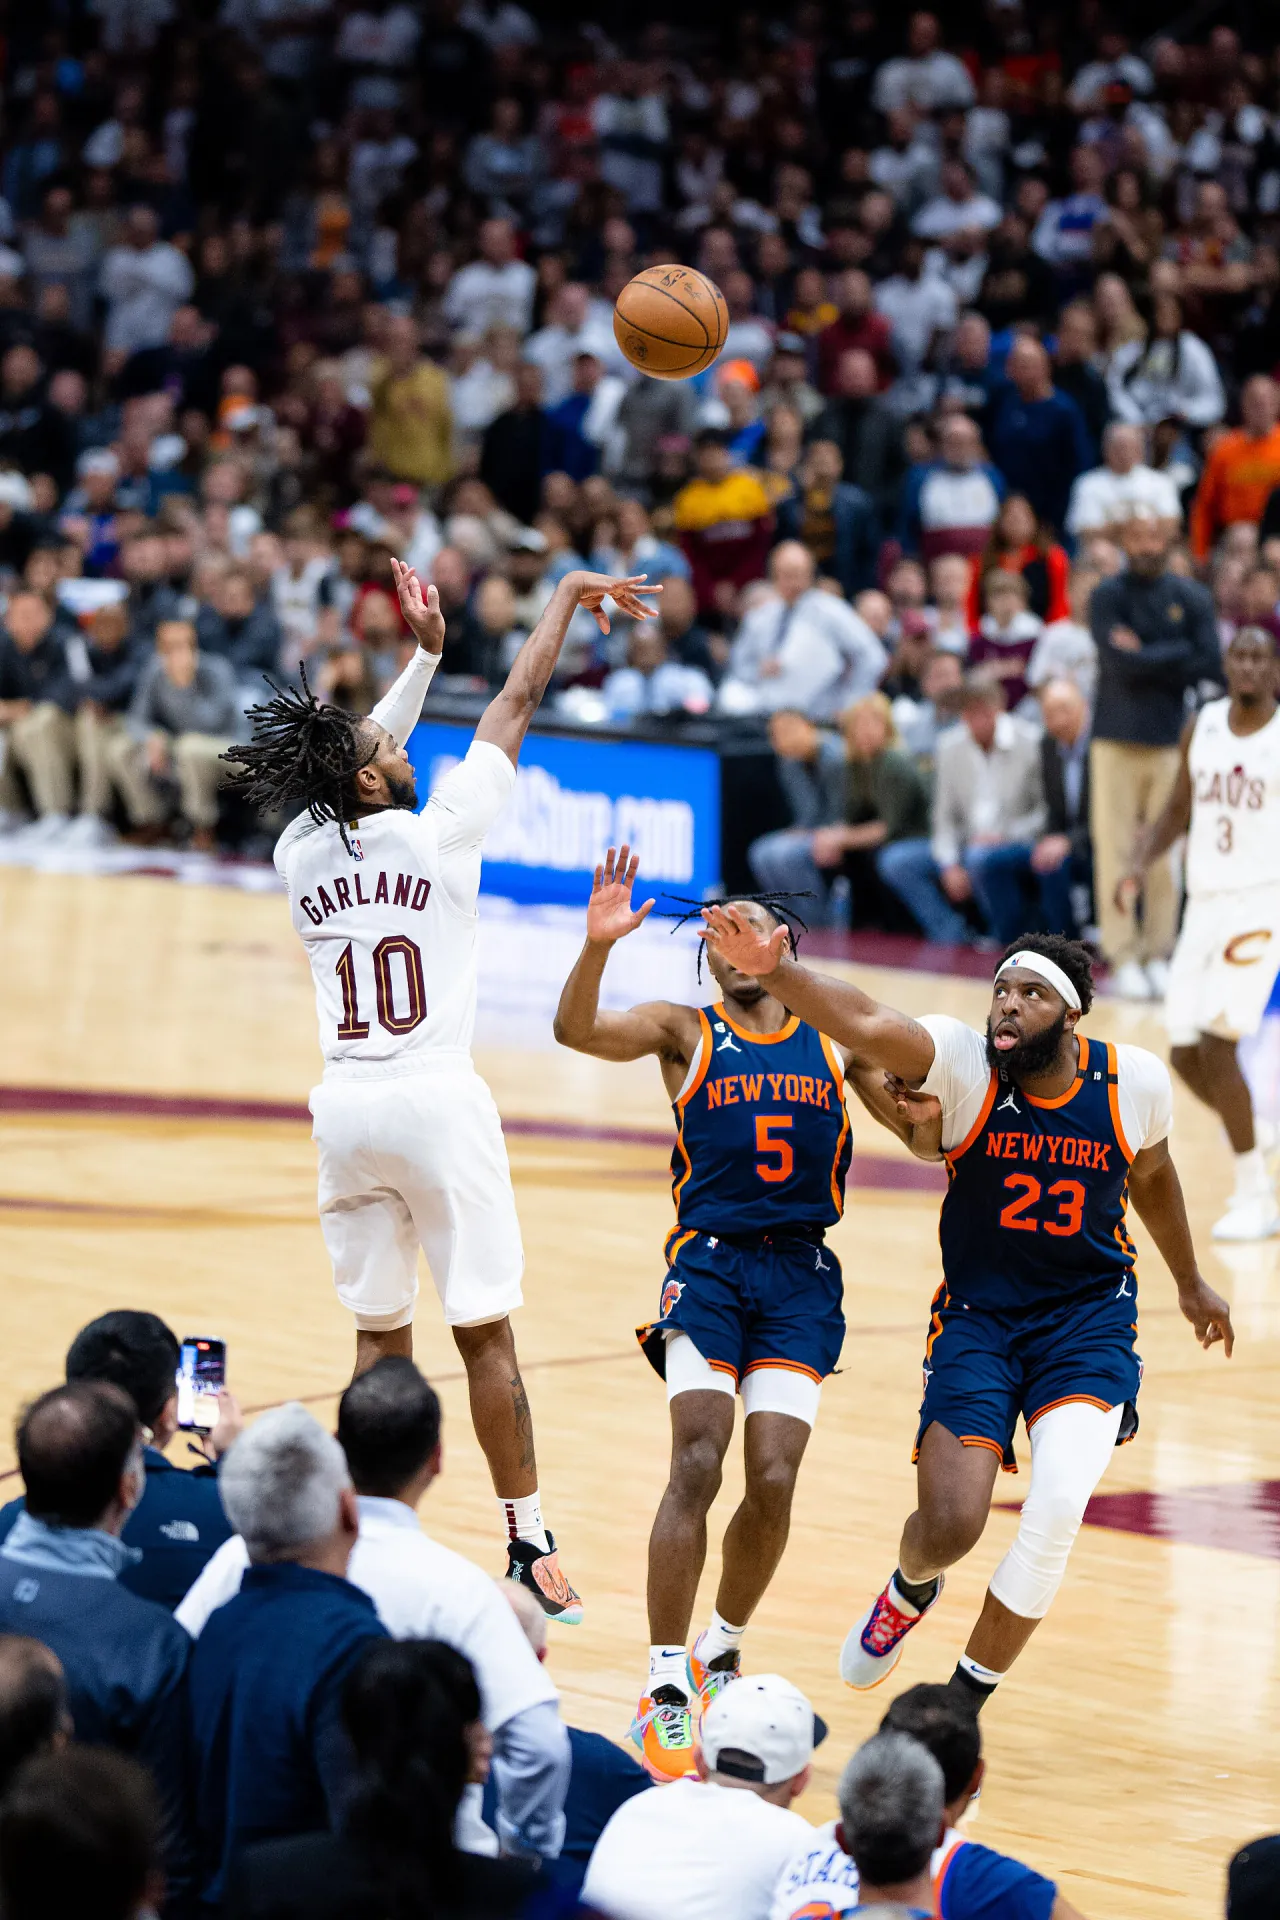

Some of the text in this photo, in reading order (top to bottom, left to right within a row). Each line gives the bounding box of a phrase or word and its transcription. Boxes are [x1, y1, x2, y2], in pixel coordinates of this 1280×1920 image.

[1216, 814, 1233, 854] 3
[300, 871, 431, 926] GARLAND
[335, 935, 427, 1041] 10
[706, 1073, 832, 1110] NEW YORK
[754, 1114, 795, 1183] 5
[985, 1132, 1112, 1172] NEW YORK
[999, 1172, 1086, 1237] 23
